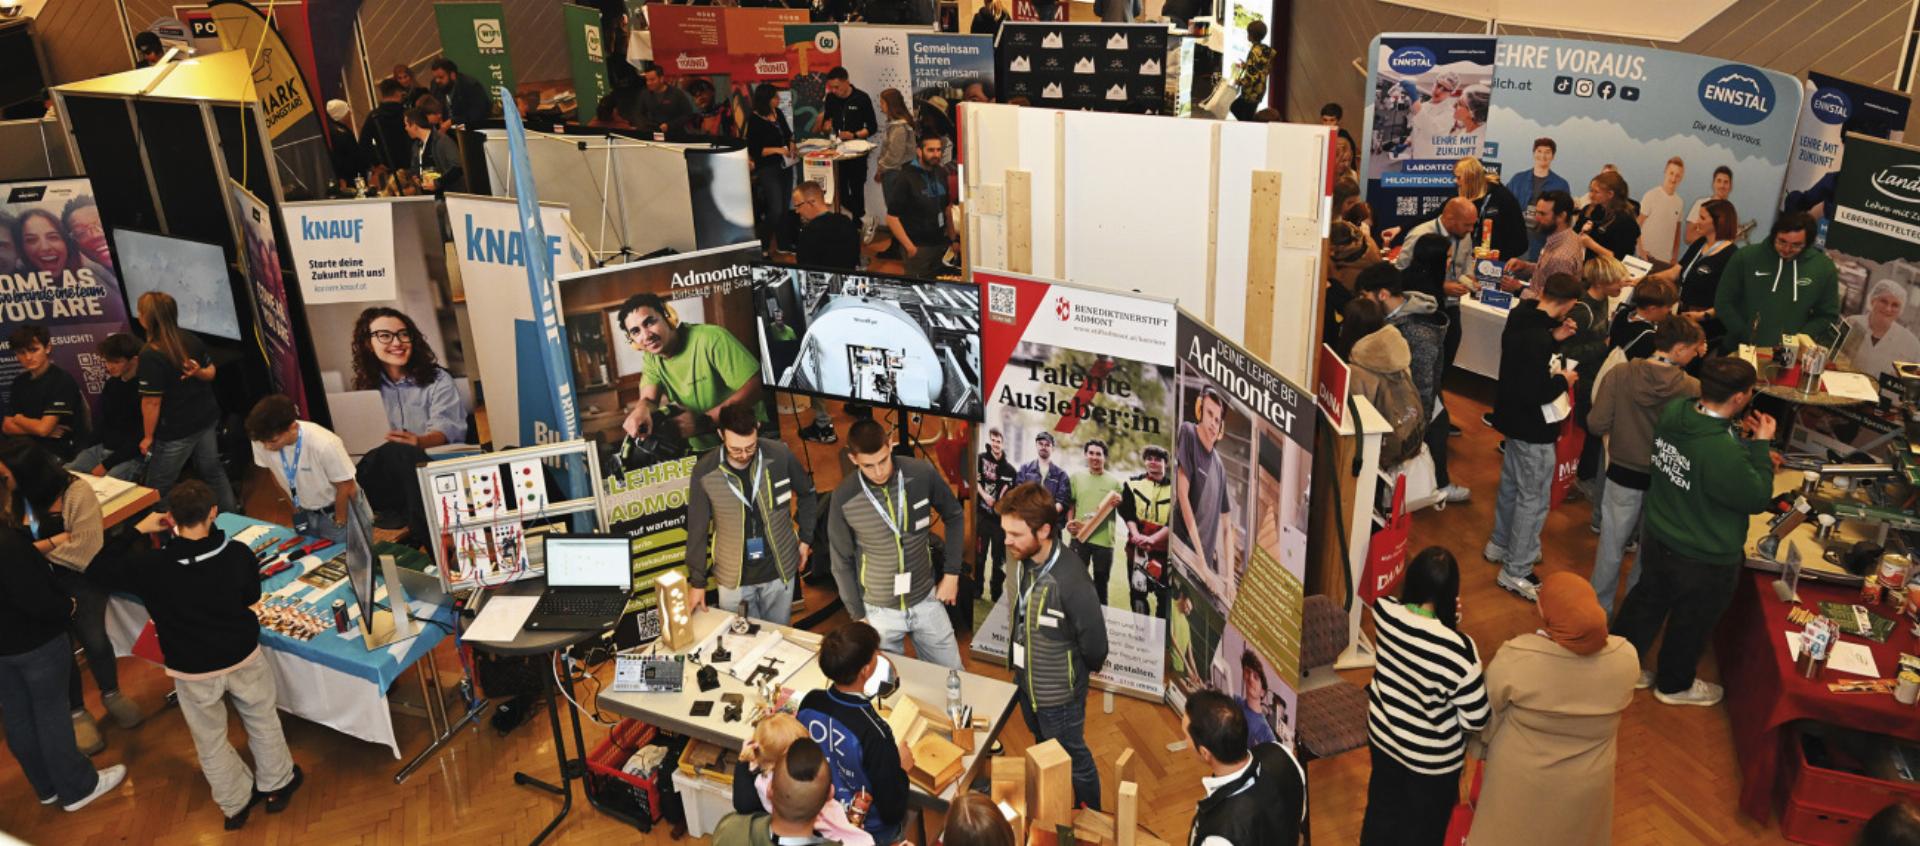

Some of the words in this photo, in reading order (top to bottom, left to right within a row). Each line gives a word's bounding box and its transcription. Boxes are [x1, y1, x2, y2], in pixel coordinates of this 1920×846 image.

[913, 43, 979, 54] Gemeinsam
[914, 55, 950, 65] fahren
[1392, 58, 1432, 67] ENNSTAL
[1555, 47, 1647, 81] VORAUS.
[915, 68, 940, 76] statt
[943, 69, 979, 78] einsam
[916, 79, 950, 88] fahren
[1704, 85, 1768, 113] ENNSTAL
[1814, 100, 1848, 118] ENNSTAL
[1692, 120, 1706, 131] Die
[1708, 123, 1730, 138] Milch
[1431, 136, 1457, 145] LEHRE
[1460, 136, 1477, 145] MIT
[1822, 141, 1839, 155] MIT
[1435, 147, 1476, 156] ZUKUNFT
[1864, 199, 1890, 213] Lehre
[1892, 208, 1910, 218] mit
[301, 215, 363, 243] KNAUF
[465, 214, 561, 281] KNAF
[308, 259, 337, 269] Starte
[339, 258, 364, 267] deine
[62, 268, 96, 289] AS
[312, 270, 347, 280] Zukunft
[349, 268, 364, 278] mit
[366, 267, 385, 277] uns!
[52, 296, 103, 319] ARE
[1074, 304, 1169, 328] BENEDIKTINERSTIFT
[1074, 315, 1113, 328] ADMONT
[1028, 359, 1131, 398] Talente
[1215, 339, 1245, 372] DEINE
[1246, 357, 1279, 396] LEHRE
[1281, 383, 1298, 408] BEI
[1188, 335, 1297, 435] Admonter
[999, 374, 1162, 434] Ausleber:in
[607, 455, 697, 495] LEHRE
[646, 514, 686, 532] warten?
